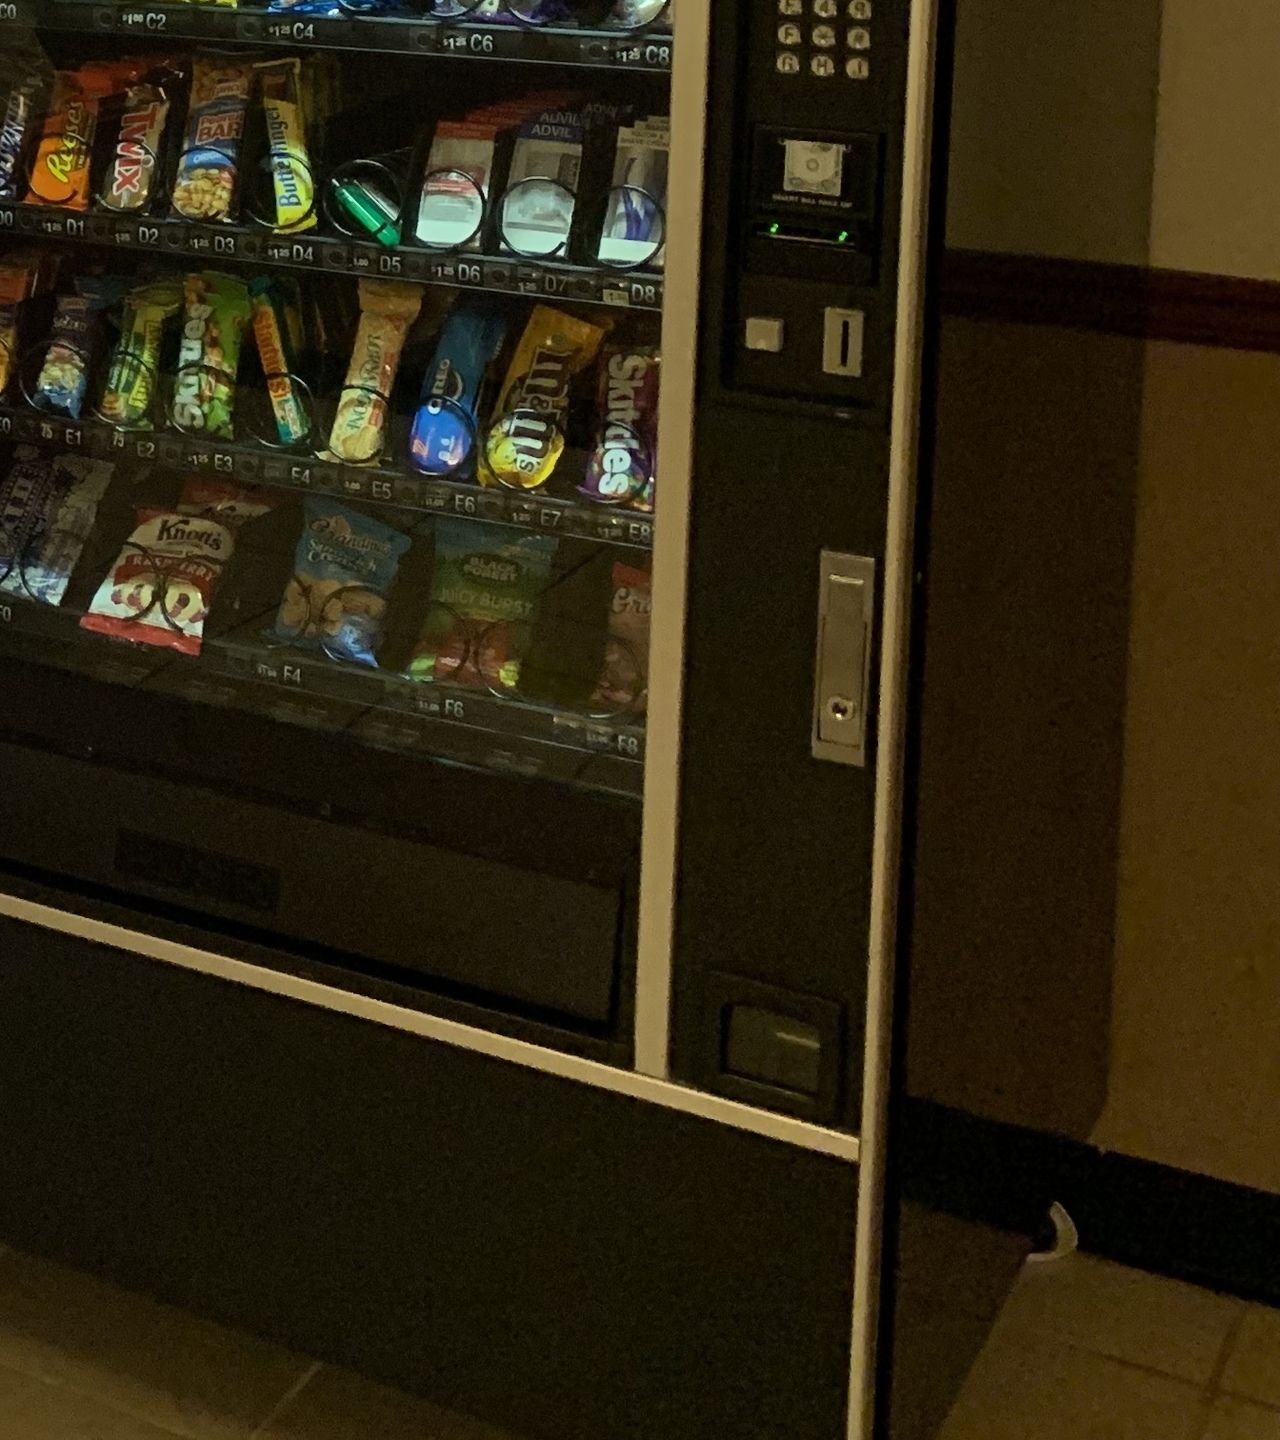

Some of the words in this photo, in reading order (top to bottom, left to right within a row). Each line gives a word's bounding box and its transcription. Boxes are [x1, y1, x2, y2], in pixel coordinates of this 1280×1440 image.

[146, 13, 167, 29] C2
[293, 23, 314, 39] C4
[470, 33, 494, 52] C6
[645, 46, 670, 63] C8
[198, 123, 242, 144] BAR
[531, 125, 573, 138] ADVIL
[46, 100, 85, 184] Reese's
[112, 101, 161, 197] TWIX
[66, 218, 85, 236] D1
[139, 226, 159, 244] D2
[214, 235, 235, 254] D3
[293, 244, 314, 261] D4
[380, 254, 401, 273] D5
[458, 262, 481, 281] D6
[544, 273, 568, 293] D7
[631, 283, 656, 304] D8
[598, 353, 648, 496] Skittles
[65, 429, 82, 445] E1
[137, 441, 156, 458] E2
[214, 454, 233, 471] E3
[291, 467, 311, 485] E4
[372, 481, 392, 499] E5
[454, 494, 475, 512] E6
[540, 508, 562, 527] E7
[628, 523, 651, 542] E8
[283, 665, 302, 684] F4
[444, 698, 465, 718] F6
[617, 735, 639, 755] F8
